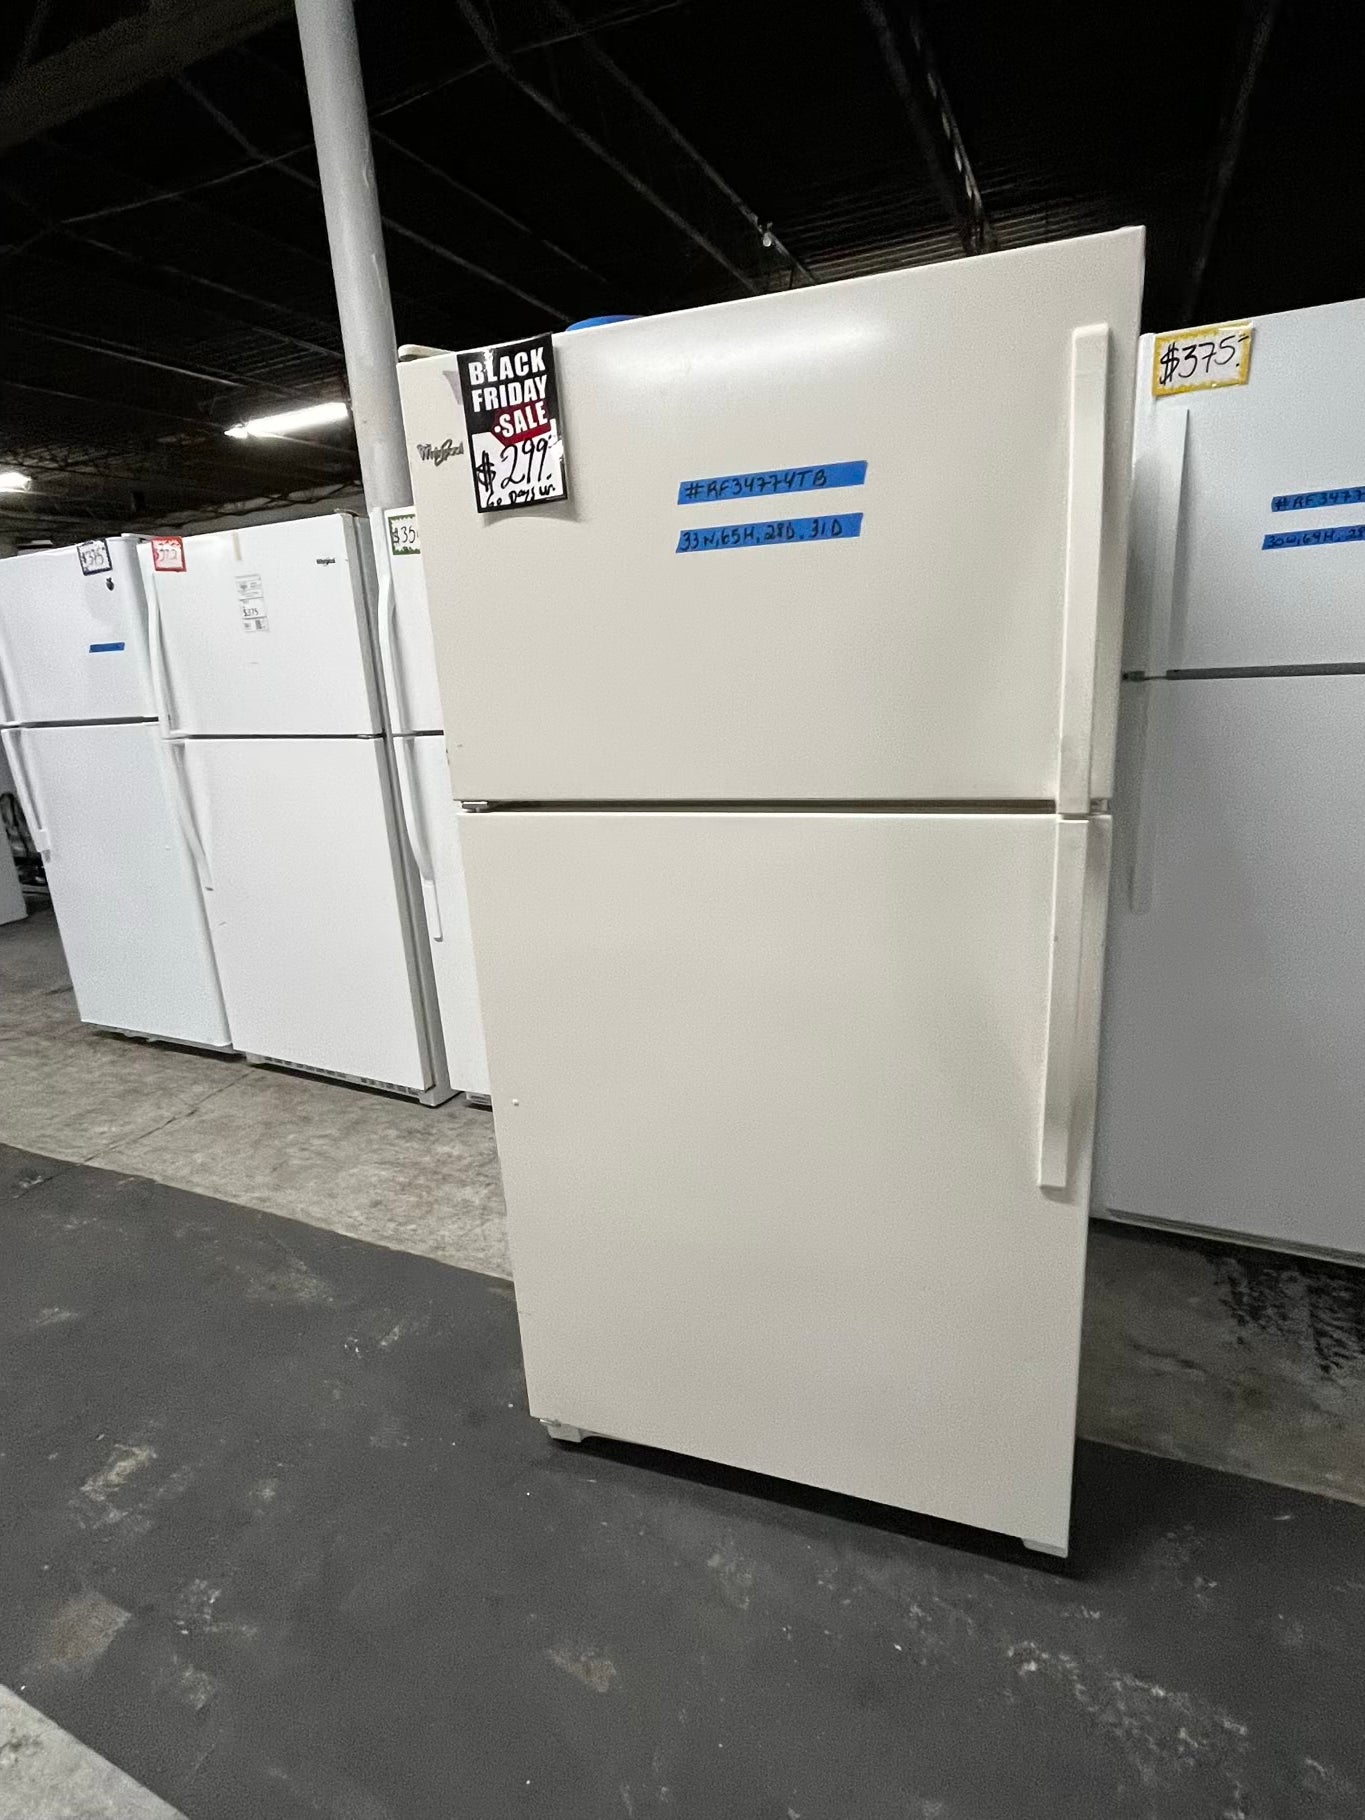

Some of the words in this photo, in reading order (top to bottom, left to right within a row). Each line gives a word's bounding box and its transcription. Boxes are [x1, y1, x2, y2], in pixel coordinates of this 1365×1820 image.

[468, 347, 546, 386] BLACK
[471, 375, 548, 413] FRIDAY
[499, 401, 548, 438] SALE
